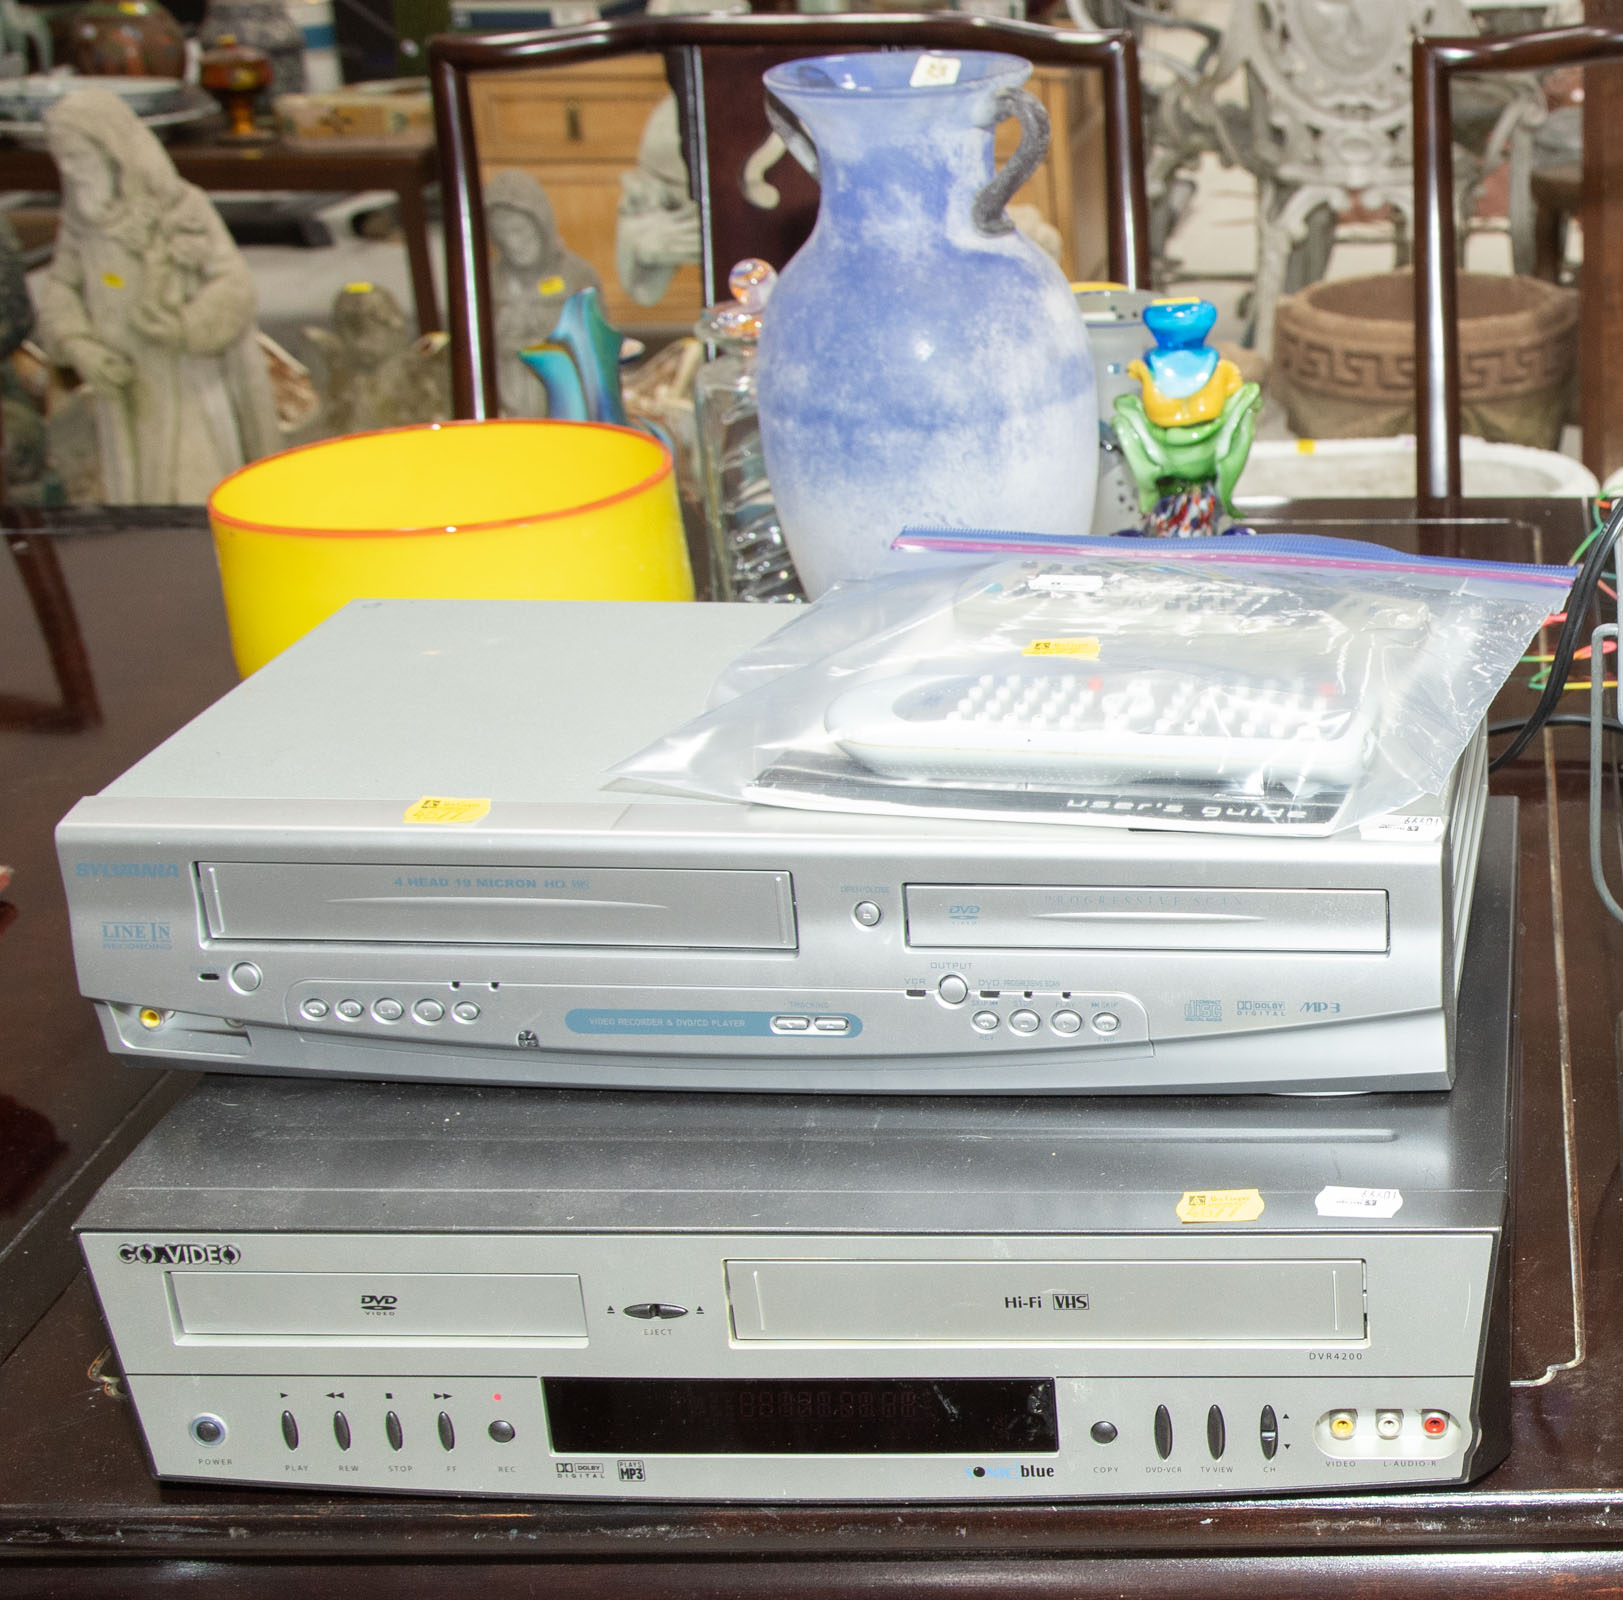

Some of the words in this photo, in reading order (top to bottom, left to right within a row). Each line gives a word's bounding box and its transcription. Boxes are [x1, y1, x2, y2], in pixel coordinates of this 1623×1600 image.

[1066, 799, 1185, 814] user's
[1201, 805, 1309, 819] guide
[75, 862, 180, 879] SYLVANIA
[407, 877, 449, 888] HEAD
[455, 878, 471, 888] 19
[475, 878, 537, 889] MICRON
[948, 904, 981, 915] DVD
[102, 924, 146, 939] LINE
[930, 961, 973, 970] OUTPUT
[905, 978, 926, 986] VCR
[978, 979, 1000, 987] DVD
[589, 1017, 616, 1026] VIDEO
[618, 1017, 664, 1027] RECORDER
[711, 1019, 746, 1028] PLAYER
[164, 1243, 242, 1265] VIDEO
[360, 1295, 399, 1306] DVD
[1004, 1295, 1042, 1309] Hi-Fi
[1054, 1295, 1088, 1309] VHS
[643, 1328, 673, 1336] EJECT
[1308, 1352, 1363, 1361] DVR4200
[198, 1458, 233, 1466] POWER
[1325, 1460, 1357, 1468] VIDEO
[285, 1464, 310, 1472] PLAY
[620, 1467, 644, 1480] MP3
[1019, 1464, 1055, 1478] blue
[1092, 1465, 1119, 1473] COPY
[1263, 1465, 1277, 1473] CH
